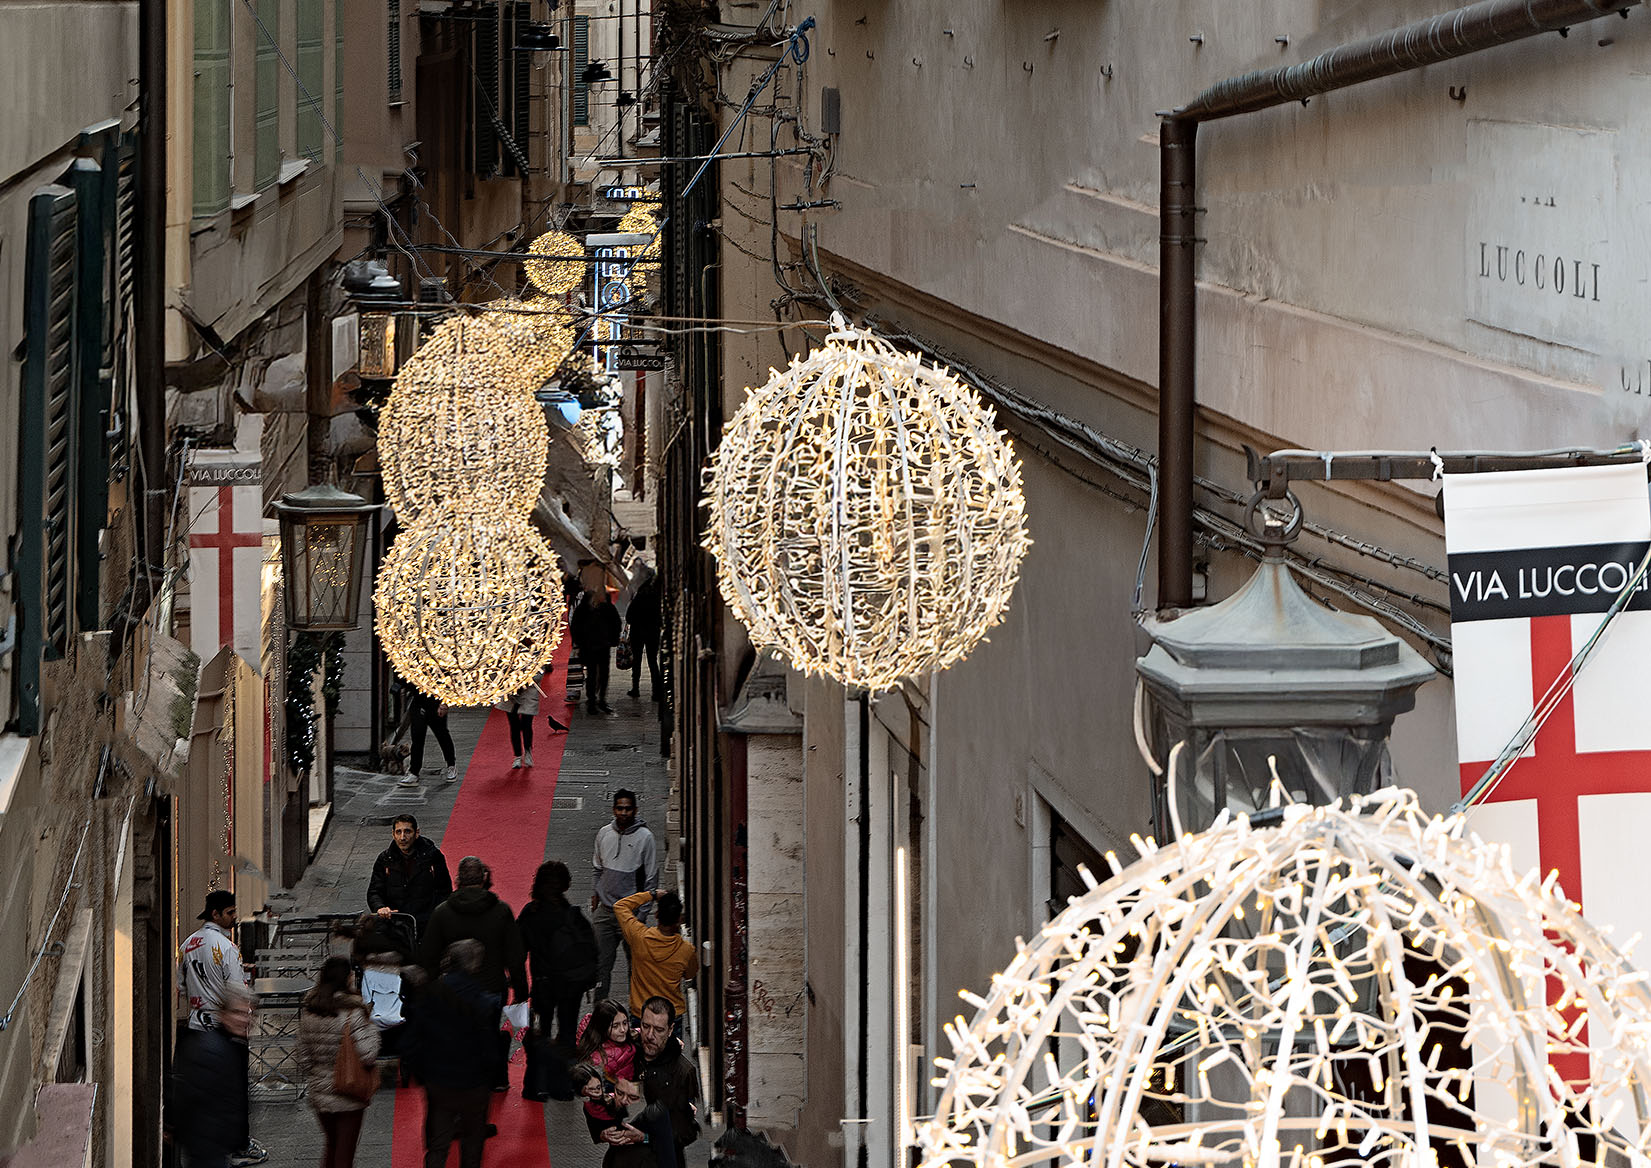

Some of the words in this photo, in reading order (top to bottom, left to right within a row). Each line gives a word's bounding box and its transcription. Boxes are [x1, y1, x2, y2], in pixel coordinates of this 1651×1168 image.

[1479, 241, 1601, 302] LUCCOLI
[190, 469, 212, 481] VIA
[1453, 569, 1510, 603] VIA
[1518, 561, 1649, 600] LUCCOLI
